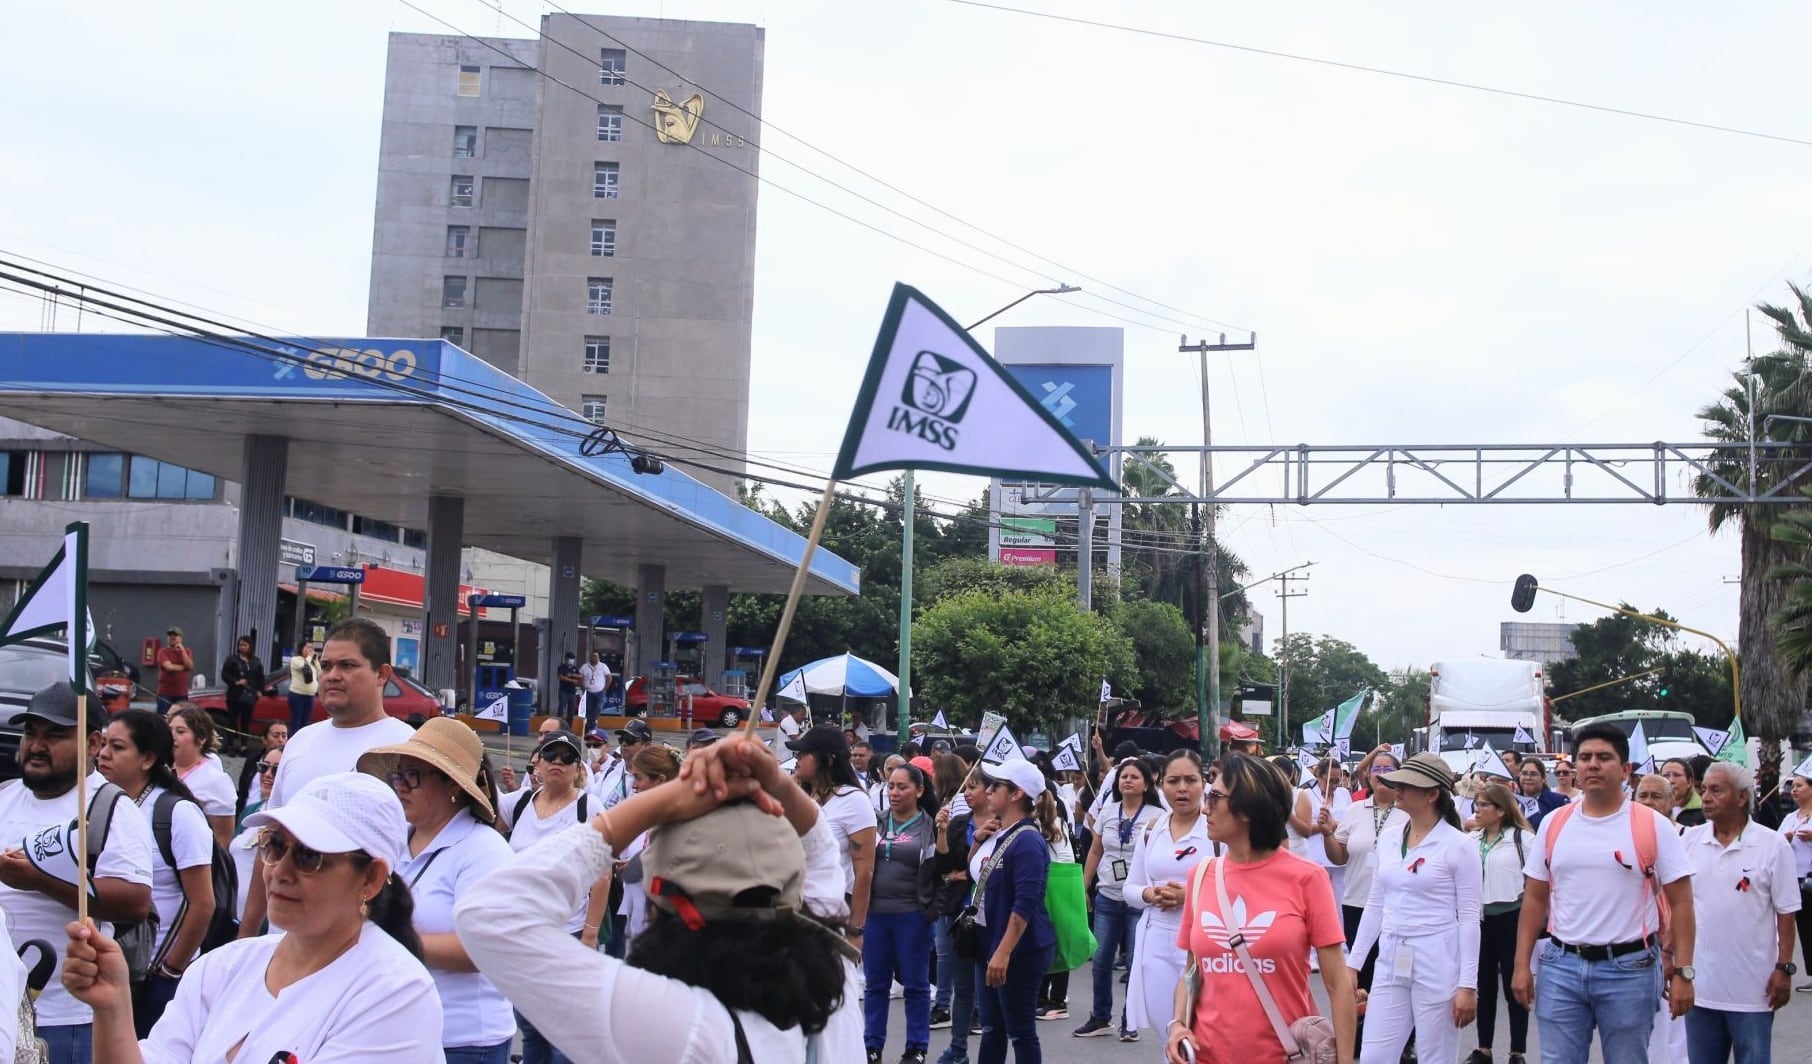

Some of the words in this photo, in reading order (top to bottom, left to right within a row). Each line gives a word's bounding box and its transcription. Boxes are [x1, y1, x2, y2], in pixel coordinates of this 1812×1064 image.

[702, 133, 745, 148] IMSS
[887, 406, 959, 451] IMSS
[1003, 536, 1031, 544] Regular
[1011, 554, 1042, 562] Premium
